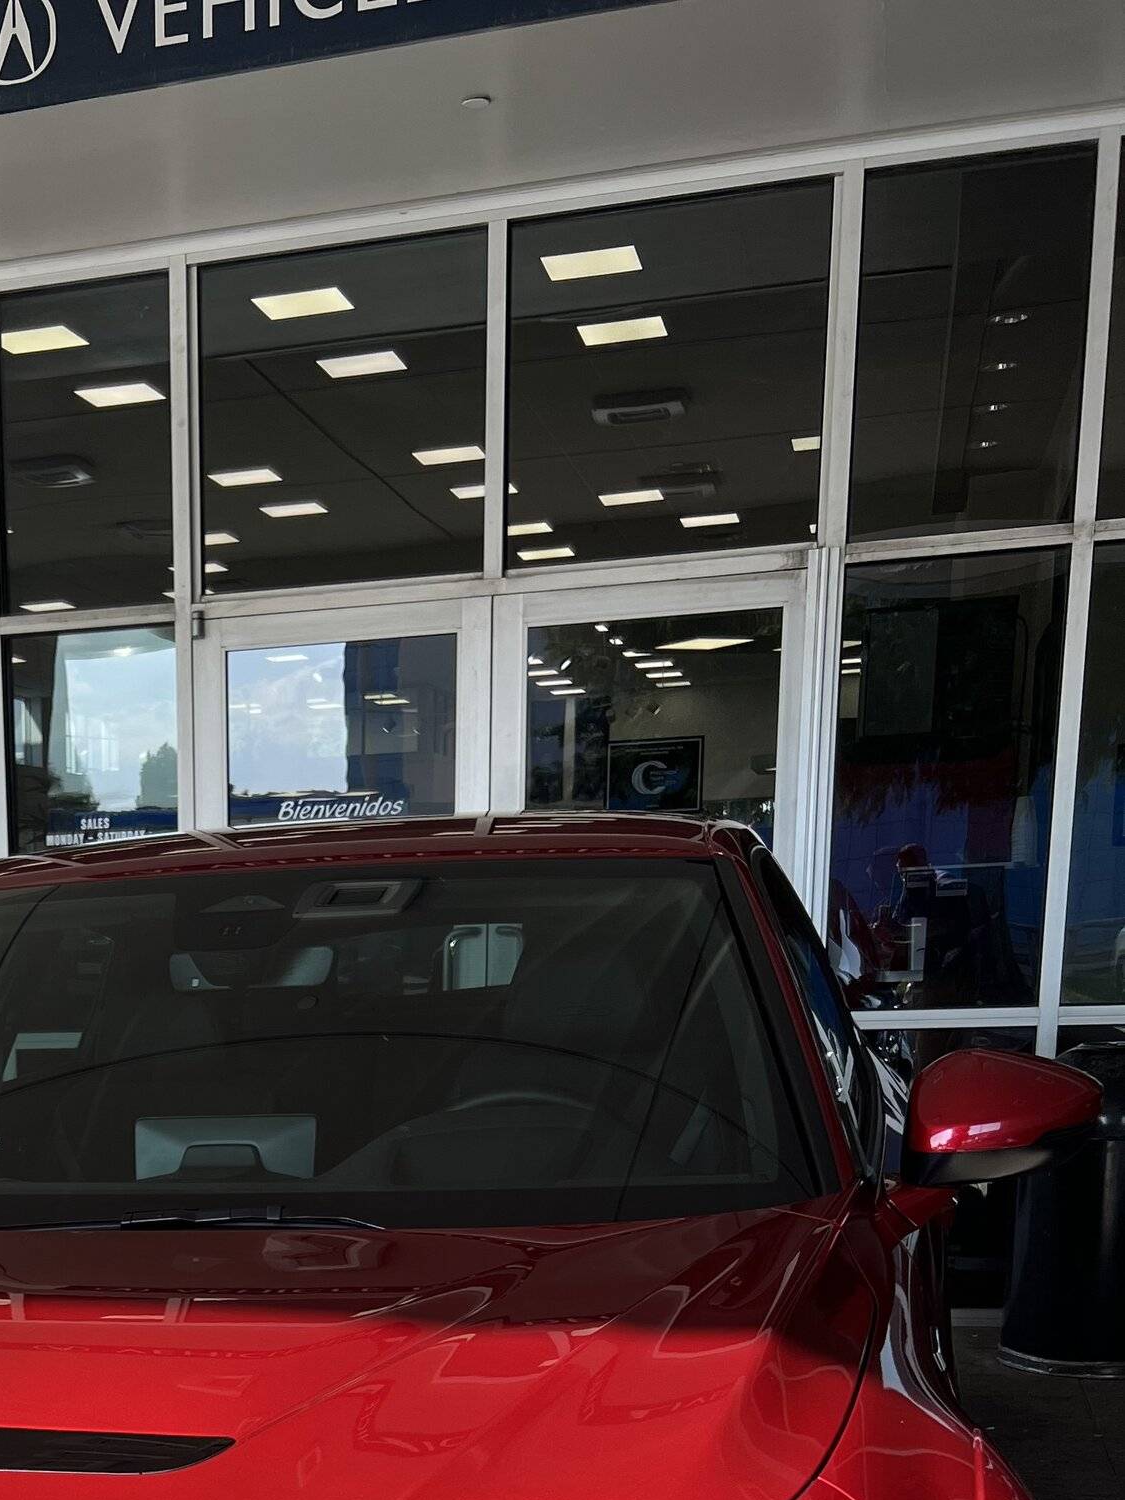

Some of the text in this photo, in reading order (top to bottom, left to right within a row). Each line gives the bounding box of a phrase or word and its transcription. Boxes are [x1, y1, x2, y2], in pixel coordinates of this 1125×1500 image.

[277, 795, 404, 821] Bienvenidos
[80, 817, 110, 830] SALES
[46, 833, 85, 846] MONDAY
